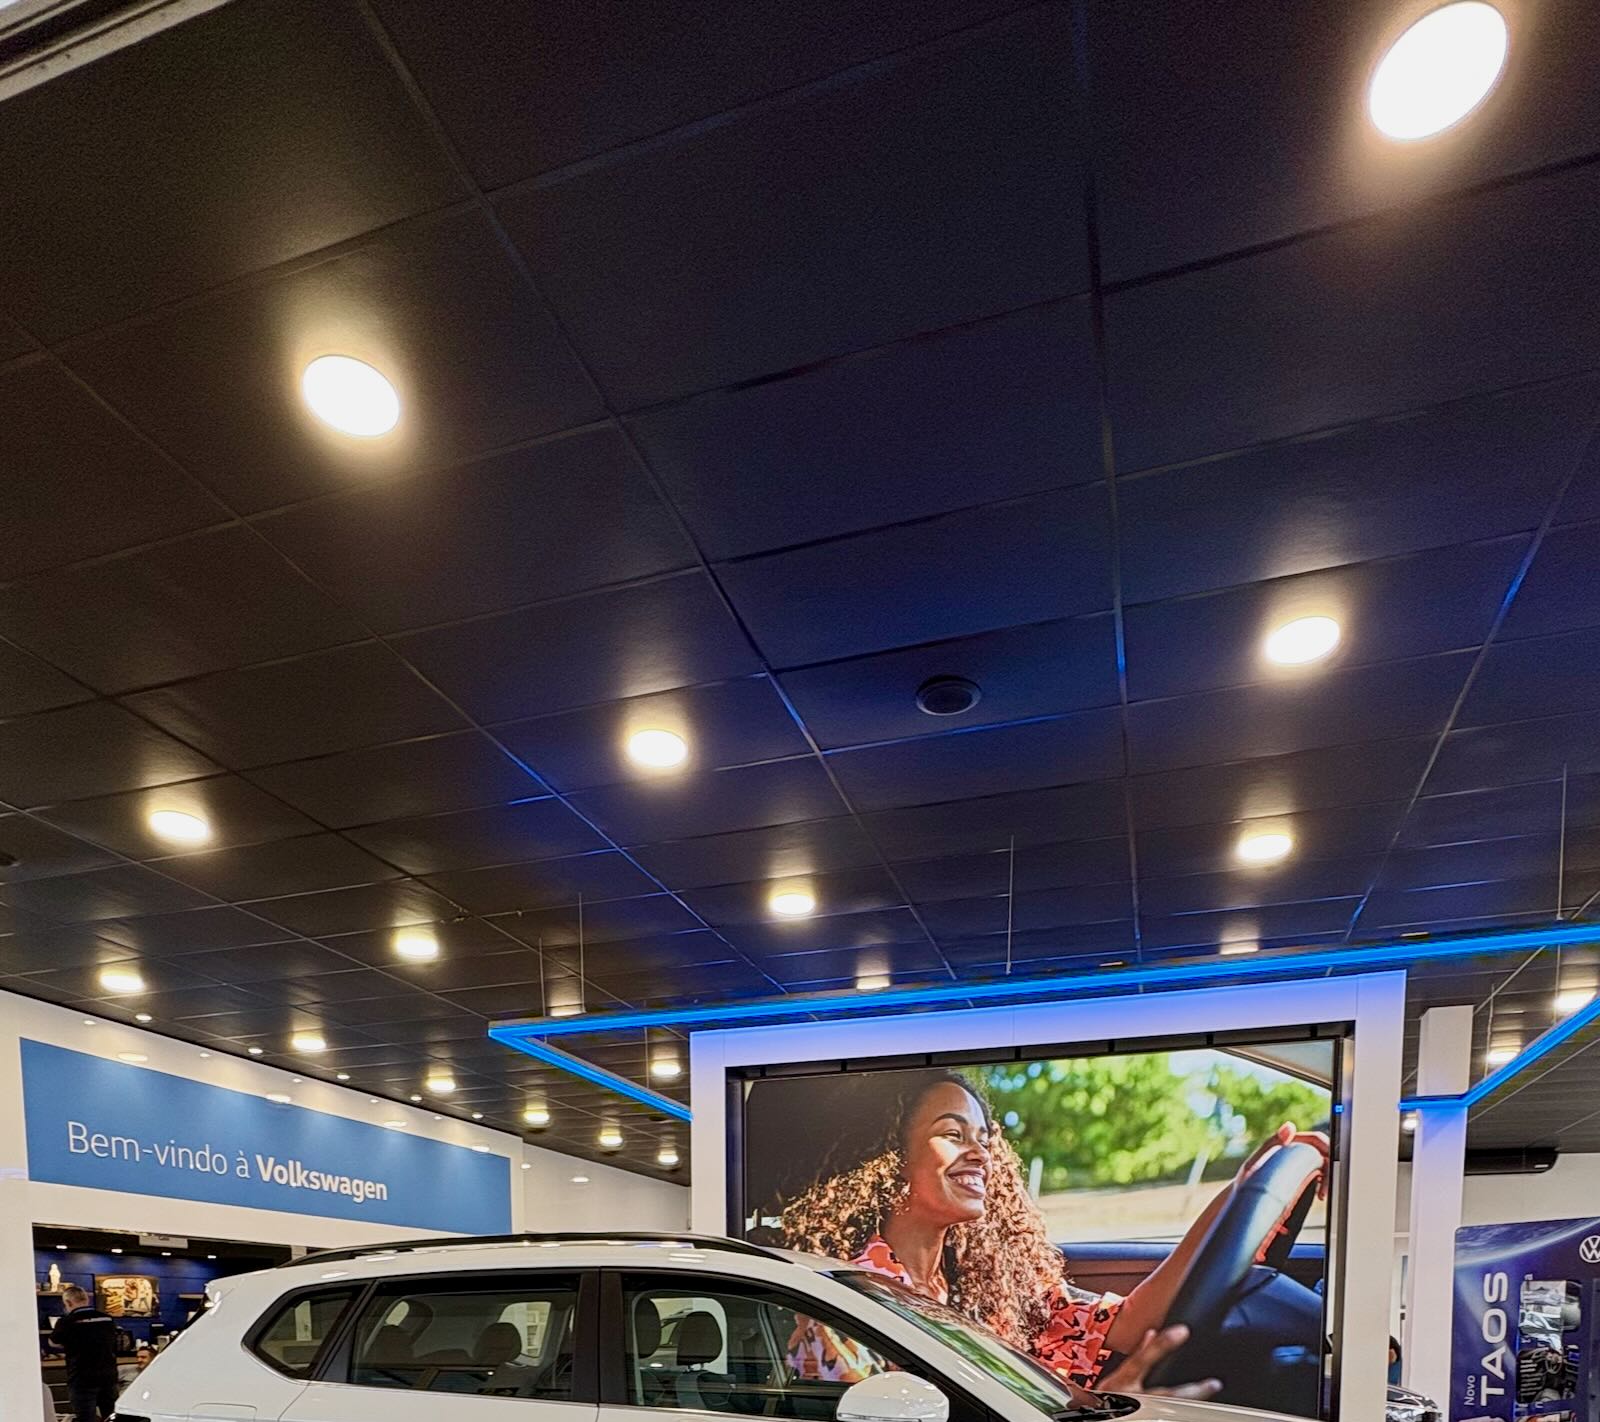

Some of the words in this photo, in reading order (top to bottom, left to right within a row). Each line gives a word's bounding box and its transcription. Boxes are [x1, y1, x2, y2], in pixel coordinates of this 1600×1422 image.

[67, 1121, 227, 1175] Bem-vindo
[236, 1150, 250, 1179] à
[255, 1154, 387, 1203] Volkswagen
[1480, 1271, 1508, 1406] TAOS
[1464, 1375, 1476, 1406] Novo
